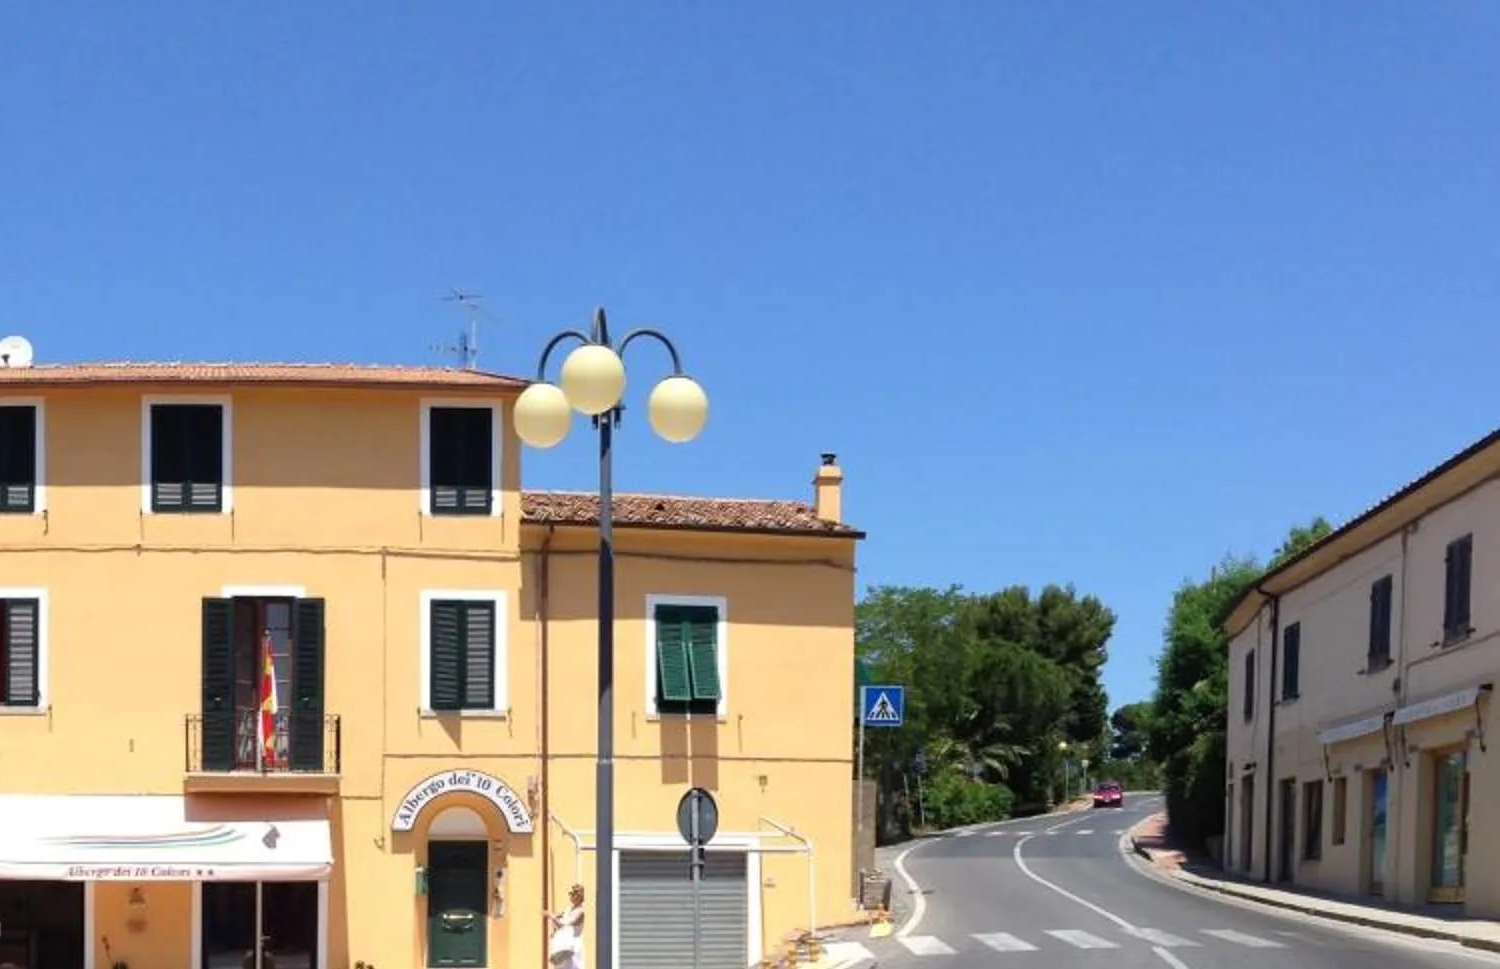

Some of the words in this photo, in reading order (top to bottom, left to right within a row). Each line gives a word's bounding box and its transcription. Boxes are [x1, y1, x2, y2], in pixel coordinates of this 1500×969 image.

[398, 780, 446, 827] Albergo
[476, 776, 492, 791] 10
[495, 784, 530, 828] Colori
